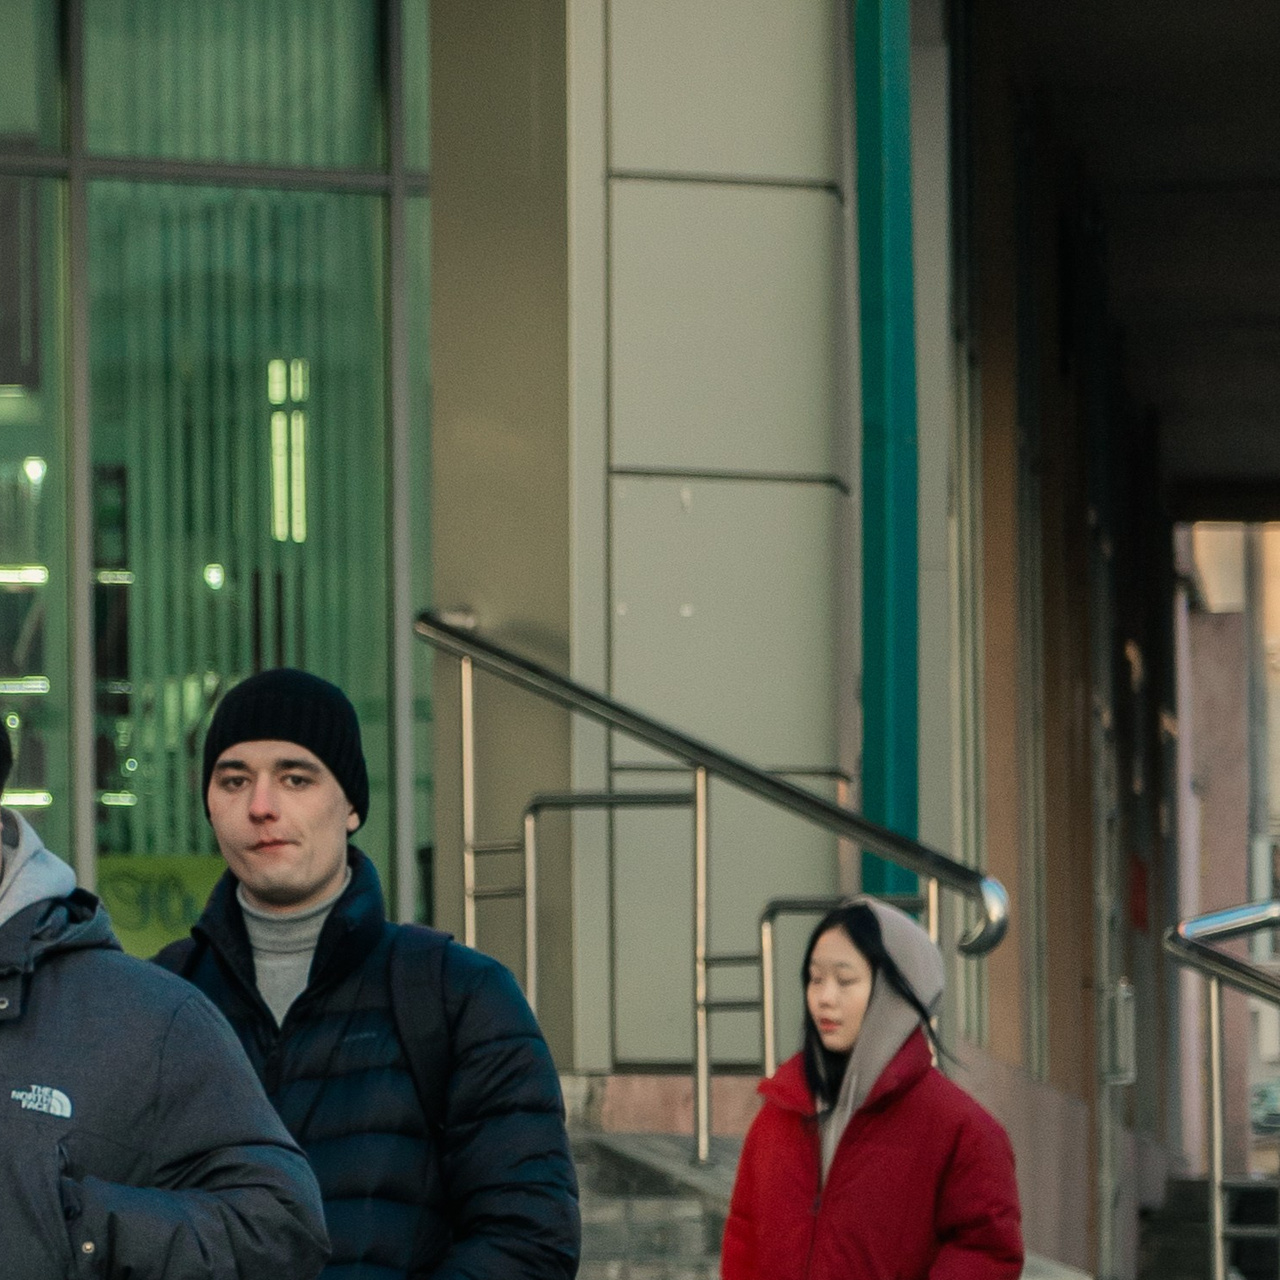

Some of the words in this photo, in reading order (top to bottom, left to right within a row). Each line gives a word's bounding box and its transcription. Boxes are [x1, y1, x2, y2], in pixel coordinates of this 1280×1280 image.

[30, 1084, 53, 1096] THE
[11, 1090, 52, 1105] NORTH
[21, 1100, 51, 1113] FACE
